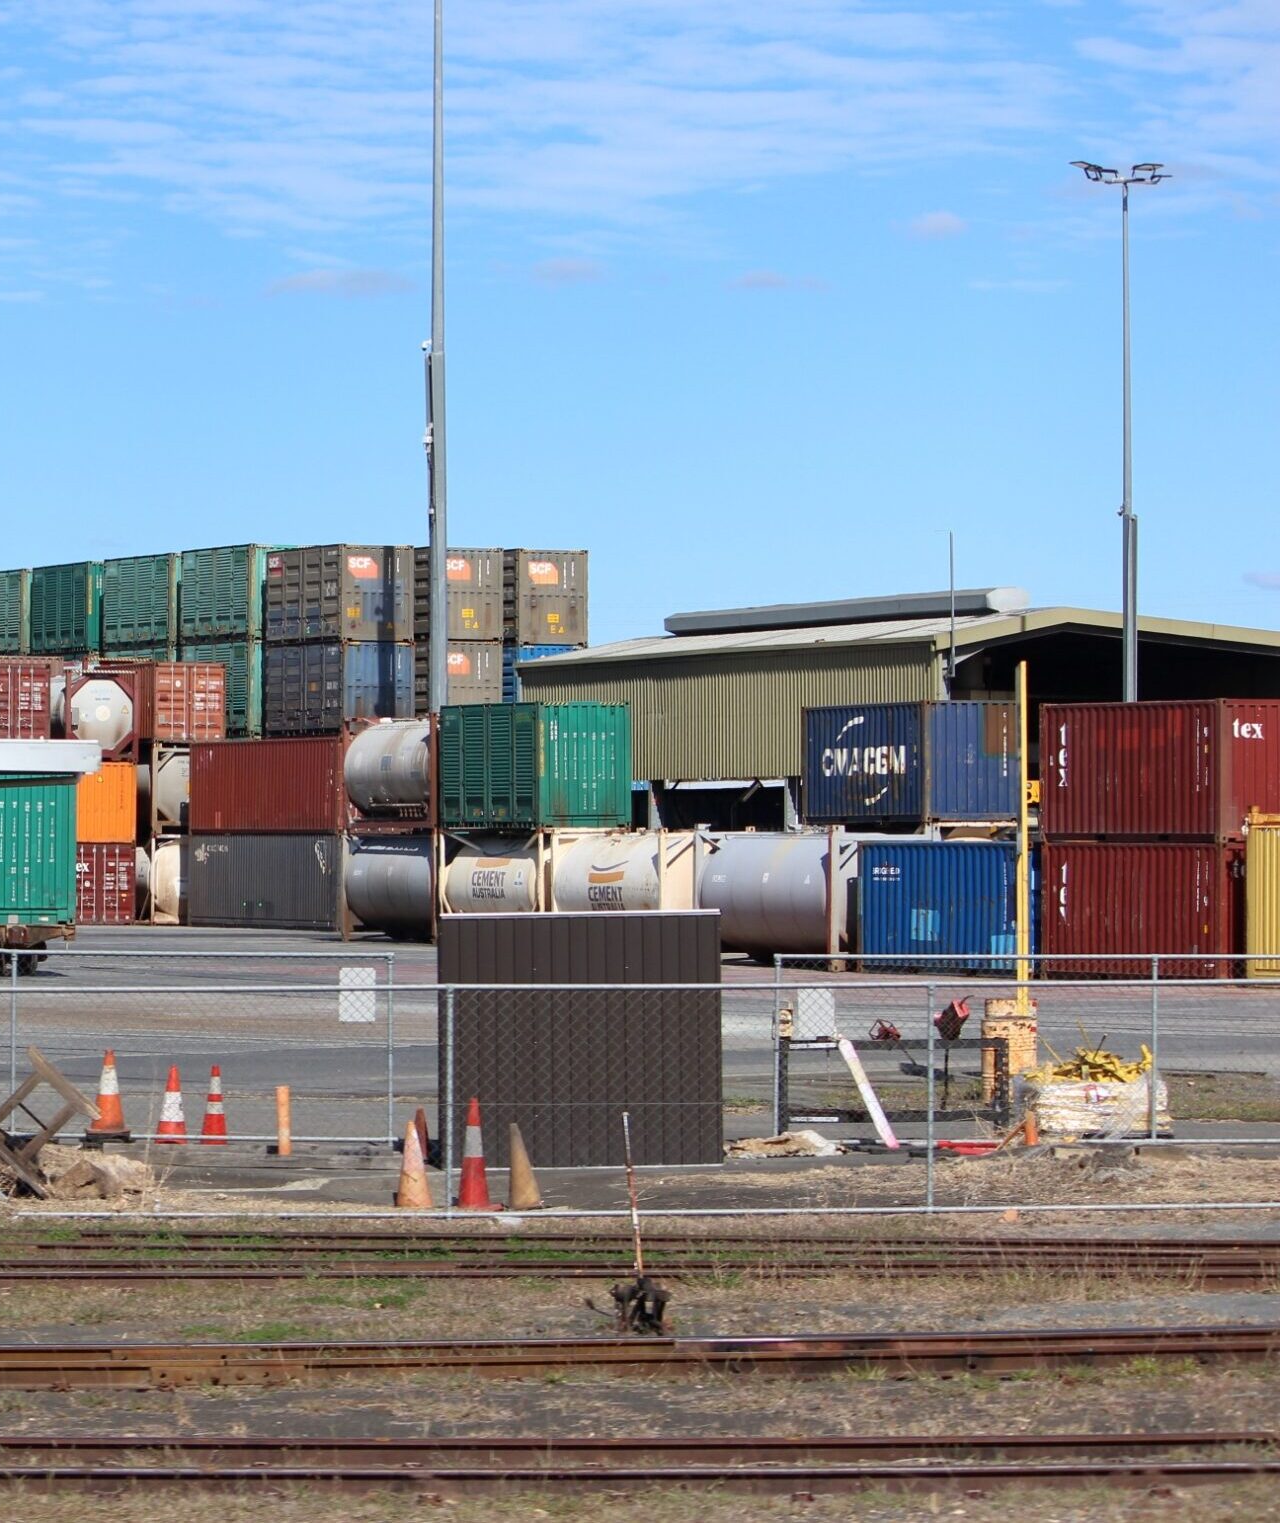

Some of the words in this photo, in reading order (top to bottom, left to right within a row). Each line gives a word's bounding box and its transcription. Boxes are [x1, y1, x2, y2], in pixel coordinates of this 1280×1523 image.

[348, 557, 372, 568] SCF
[528, 562, 552, 574] SCF
[1232, 718, 1265, 740] tex
[75, 862, 90, 873] ex
[472, 870, 506, 887] CEMENT
[472, 888, 506, 899] AUSTRALIA
[588, 886, 623, 902] CEMENT
